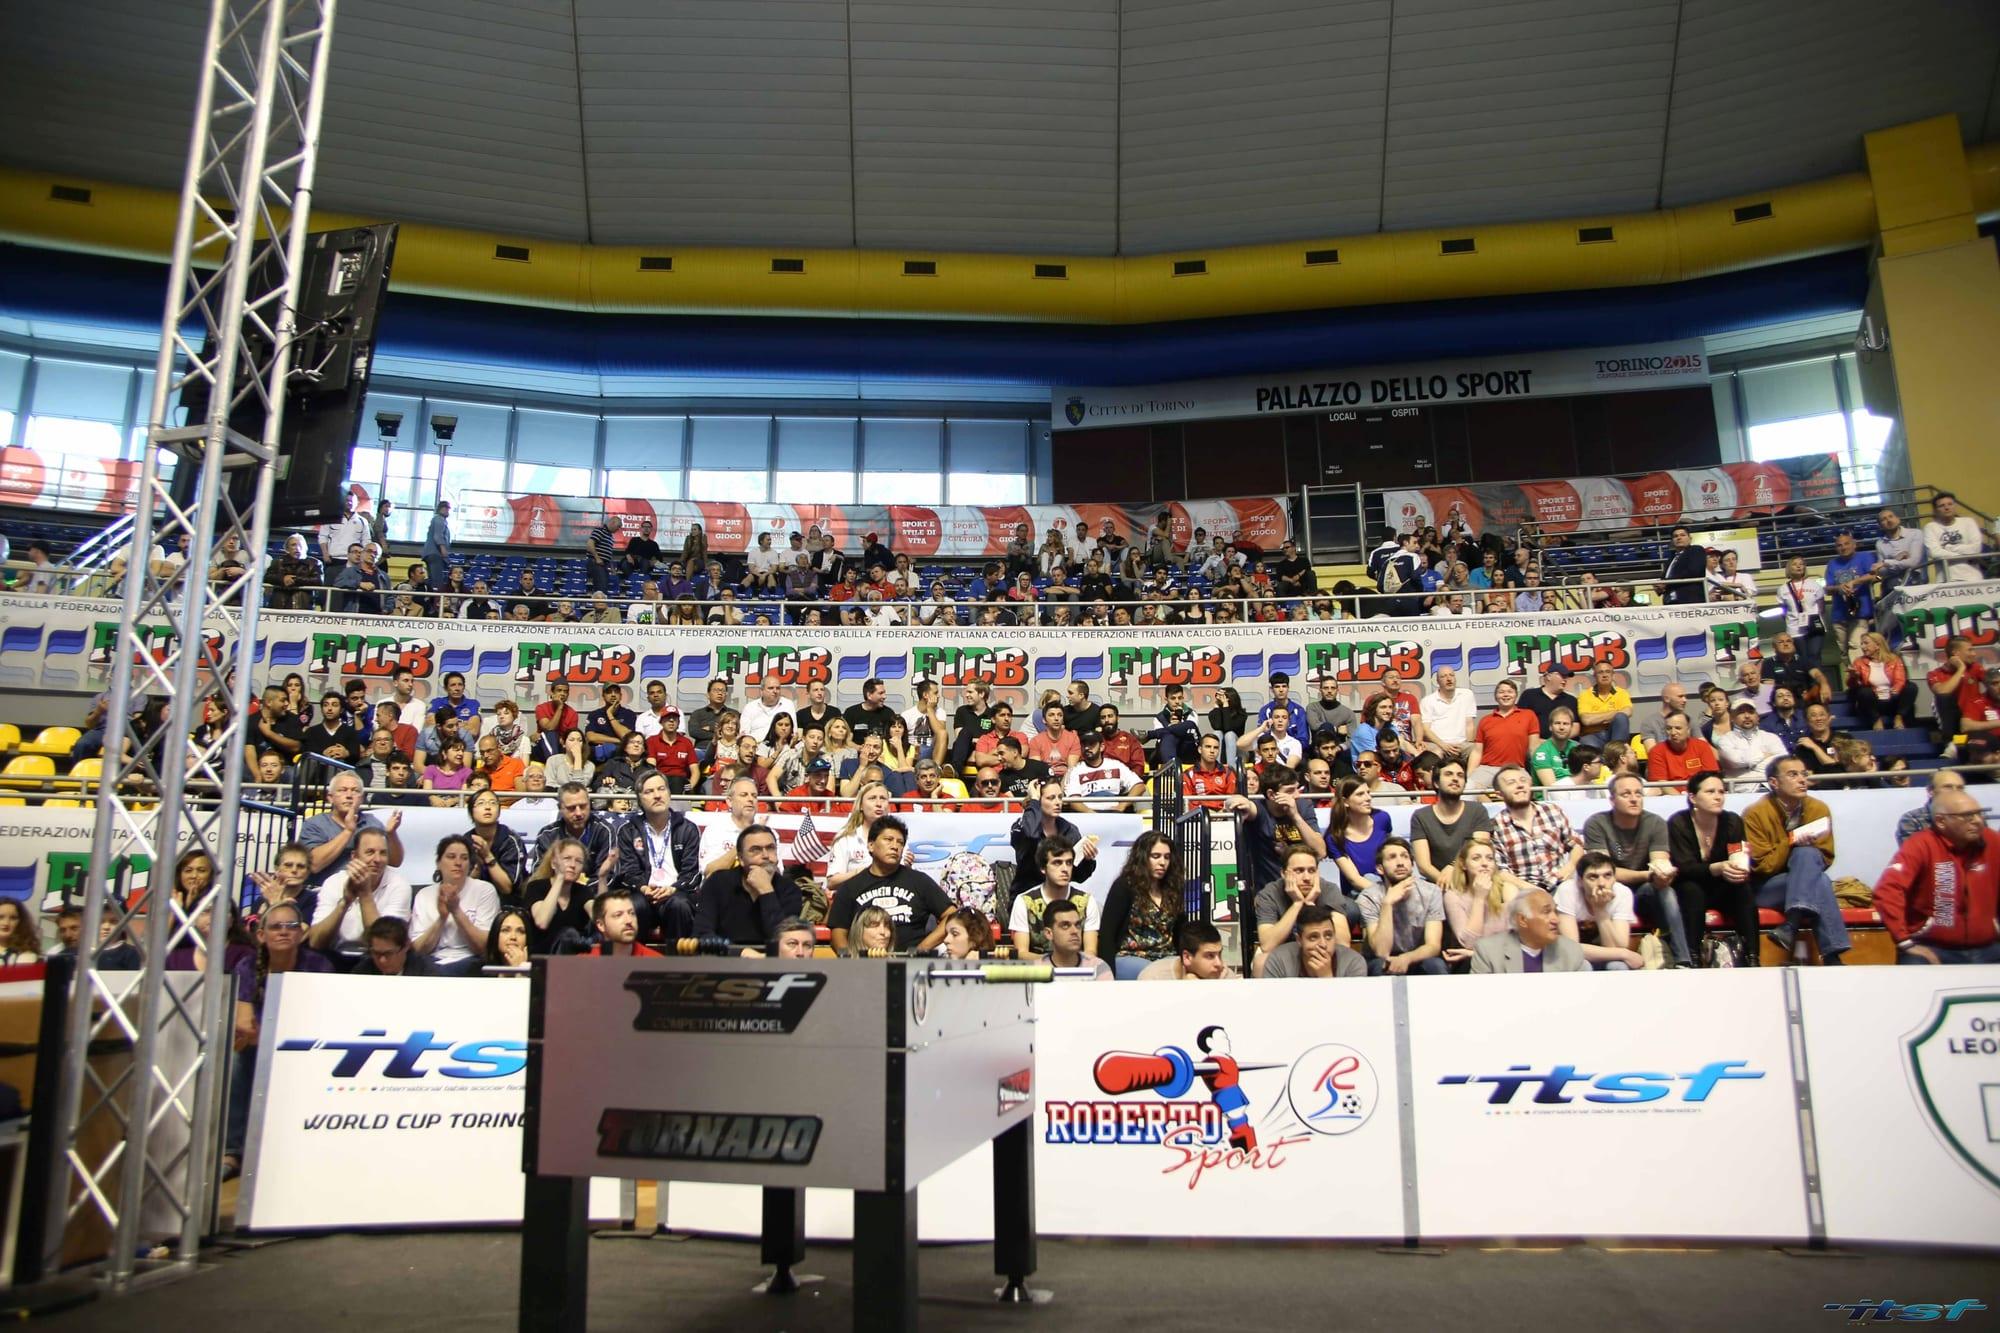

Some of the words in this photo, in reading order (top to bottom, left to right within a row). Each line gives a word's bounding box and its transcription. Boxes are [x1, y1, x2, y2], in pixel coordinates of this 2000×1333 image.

[1256, 381, 1362, 411] PALAZZO
[1370, 375, 1448, 403] DELLO
[1456, 369, 1532, 398] SPORT
[1132, 403, 1144, 413] DI
[1147, 399, 1195, 413] TORINO
[1329, 411, 1357, 422] LOCALI
[1391, 407, 1419, 418] OSPITI
[1537, 497, 1565, 505] SPORT
[1643, 489, 1670, 498] SPORT
[1565, 504, 1576, 512] DI
[1644, 504, 1673, 512] GIOCO
[902, 520, 928, 528] SPORT
[907, 537, 927, 545] VITA
[1, 598, 49, 609] BALILLA
[54, 601, 124, 614] FEDERAZION
[1668, 607, 1741, 619] FEDERAZIONE
[276, 614, 348, 627] FEDERAZIONE
[350, 618, 396, 629] ITALIANA
[398, 620, 435, 631] CALCIO
[437, 622, 478, 632] BALILLA
[1465, 619, 1535, 630] FEDERAZIONE
[1537, 616, 1581, 627] ITALIANA
[1583, 614, 1622, 625] CALCIO
[1624, 612, 1665, 622] BALILLA
[482, 624, 551, 635] FEDERAZIONE
[553, 626, 597, 636] ITALIANA
[599, 627, 635, 636] CALCIO
[637, 627, 676, 637] BALILLA
[680, 628, 748, 638] FEDERAZIONE
[750, 629, 794, 638] ITALIANA
[796, 629, 832, 638] CALCIO
[834, 629, 872, 638] BALILLA
[876, 630, 943, 639] FEDERAZIONE
[946, 630, 989, 639] ITALIANA
[991, 630, 1027, 639] CALCIO
[1029, 630, 1068, 639] BALILLA
[1072, 630, 1139, 639] FEDERAZIONE
[1141, 629, 1184, 638] ITALIANA
[1186, 628, 1222, 638] CALCIO
[1224, 628, 1264, 637] BALILLA
[1267, 626, 1335, 636] FEDERAZIONE
[1337, 625, 1381, 635] ITALIANA
[1383, 623, 1419, 633] CALCIO
[1421, 622, 1462, 632] BALILLA
[308, 632, 436, 680] FICB
[1504, 630, 1632, 676] FICB
[514, 641, 638, 685] FICB
[714, 645, 832, 687] FICB
[911, 645, 1030, 687] FICB
[1108, 644, 1225, 687] FICB
[1305, 640, 1426, 683] FICB
[0, 824, 96, 839] EDERAZION
[856, 886, 892, 906] KENNETH
[893, 886, 915, 902] COLE
[654, 1018, 737, 1031] COMPETITION
[740, 1018, 785, 1032] MODEL
[277, 1029, 527, 1079] its
[1437, 1060, 1766, 1105] itsf
[304, 1113, 388, 1130] WORLD
[396, 1113, 442, 1130] CUP
[1045, 1101, 1224, 1145] ROBERTO
[600, 1110, 820, 1162] TORNADO
[1162, 1125, 1310, 1190] Sport
